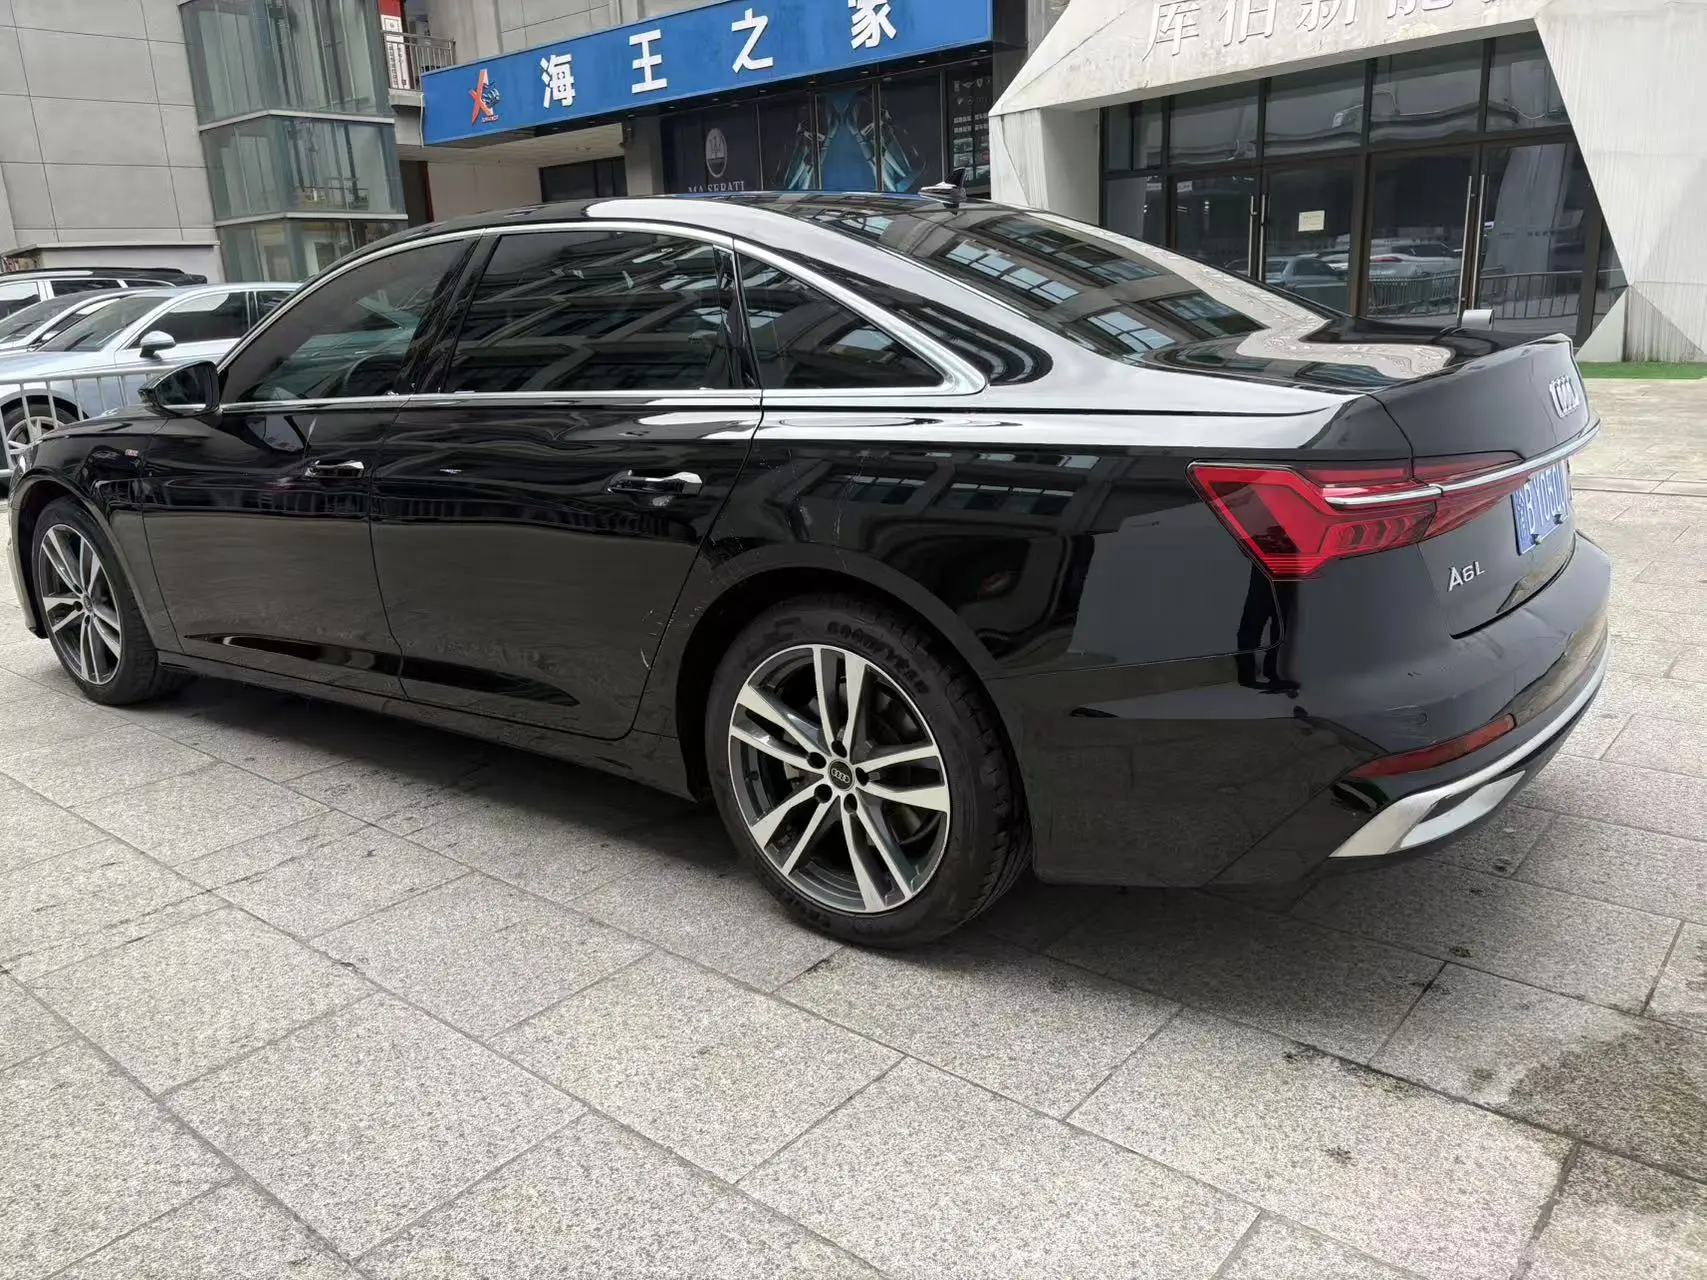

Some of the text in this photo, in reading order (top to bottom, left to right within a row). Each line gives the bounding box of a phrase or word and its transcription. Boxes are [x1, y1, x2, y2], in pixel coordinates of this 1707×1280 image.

[540, 0, 897, 109] 海王之家
[1142, 0, 1494, 62] 库伯新
[1448, 561, 1486, 593] A6L
